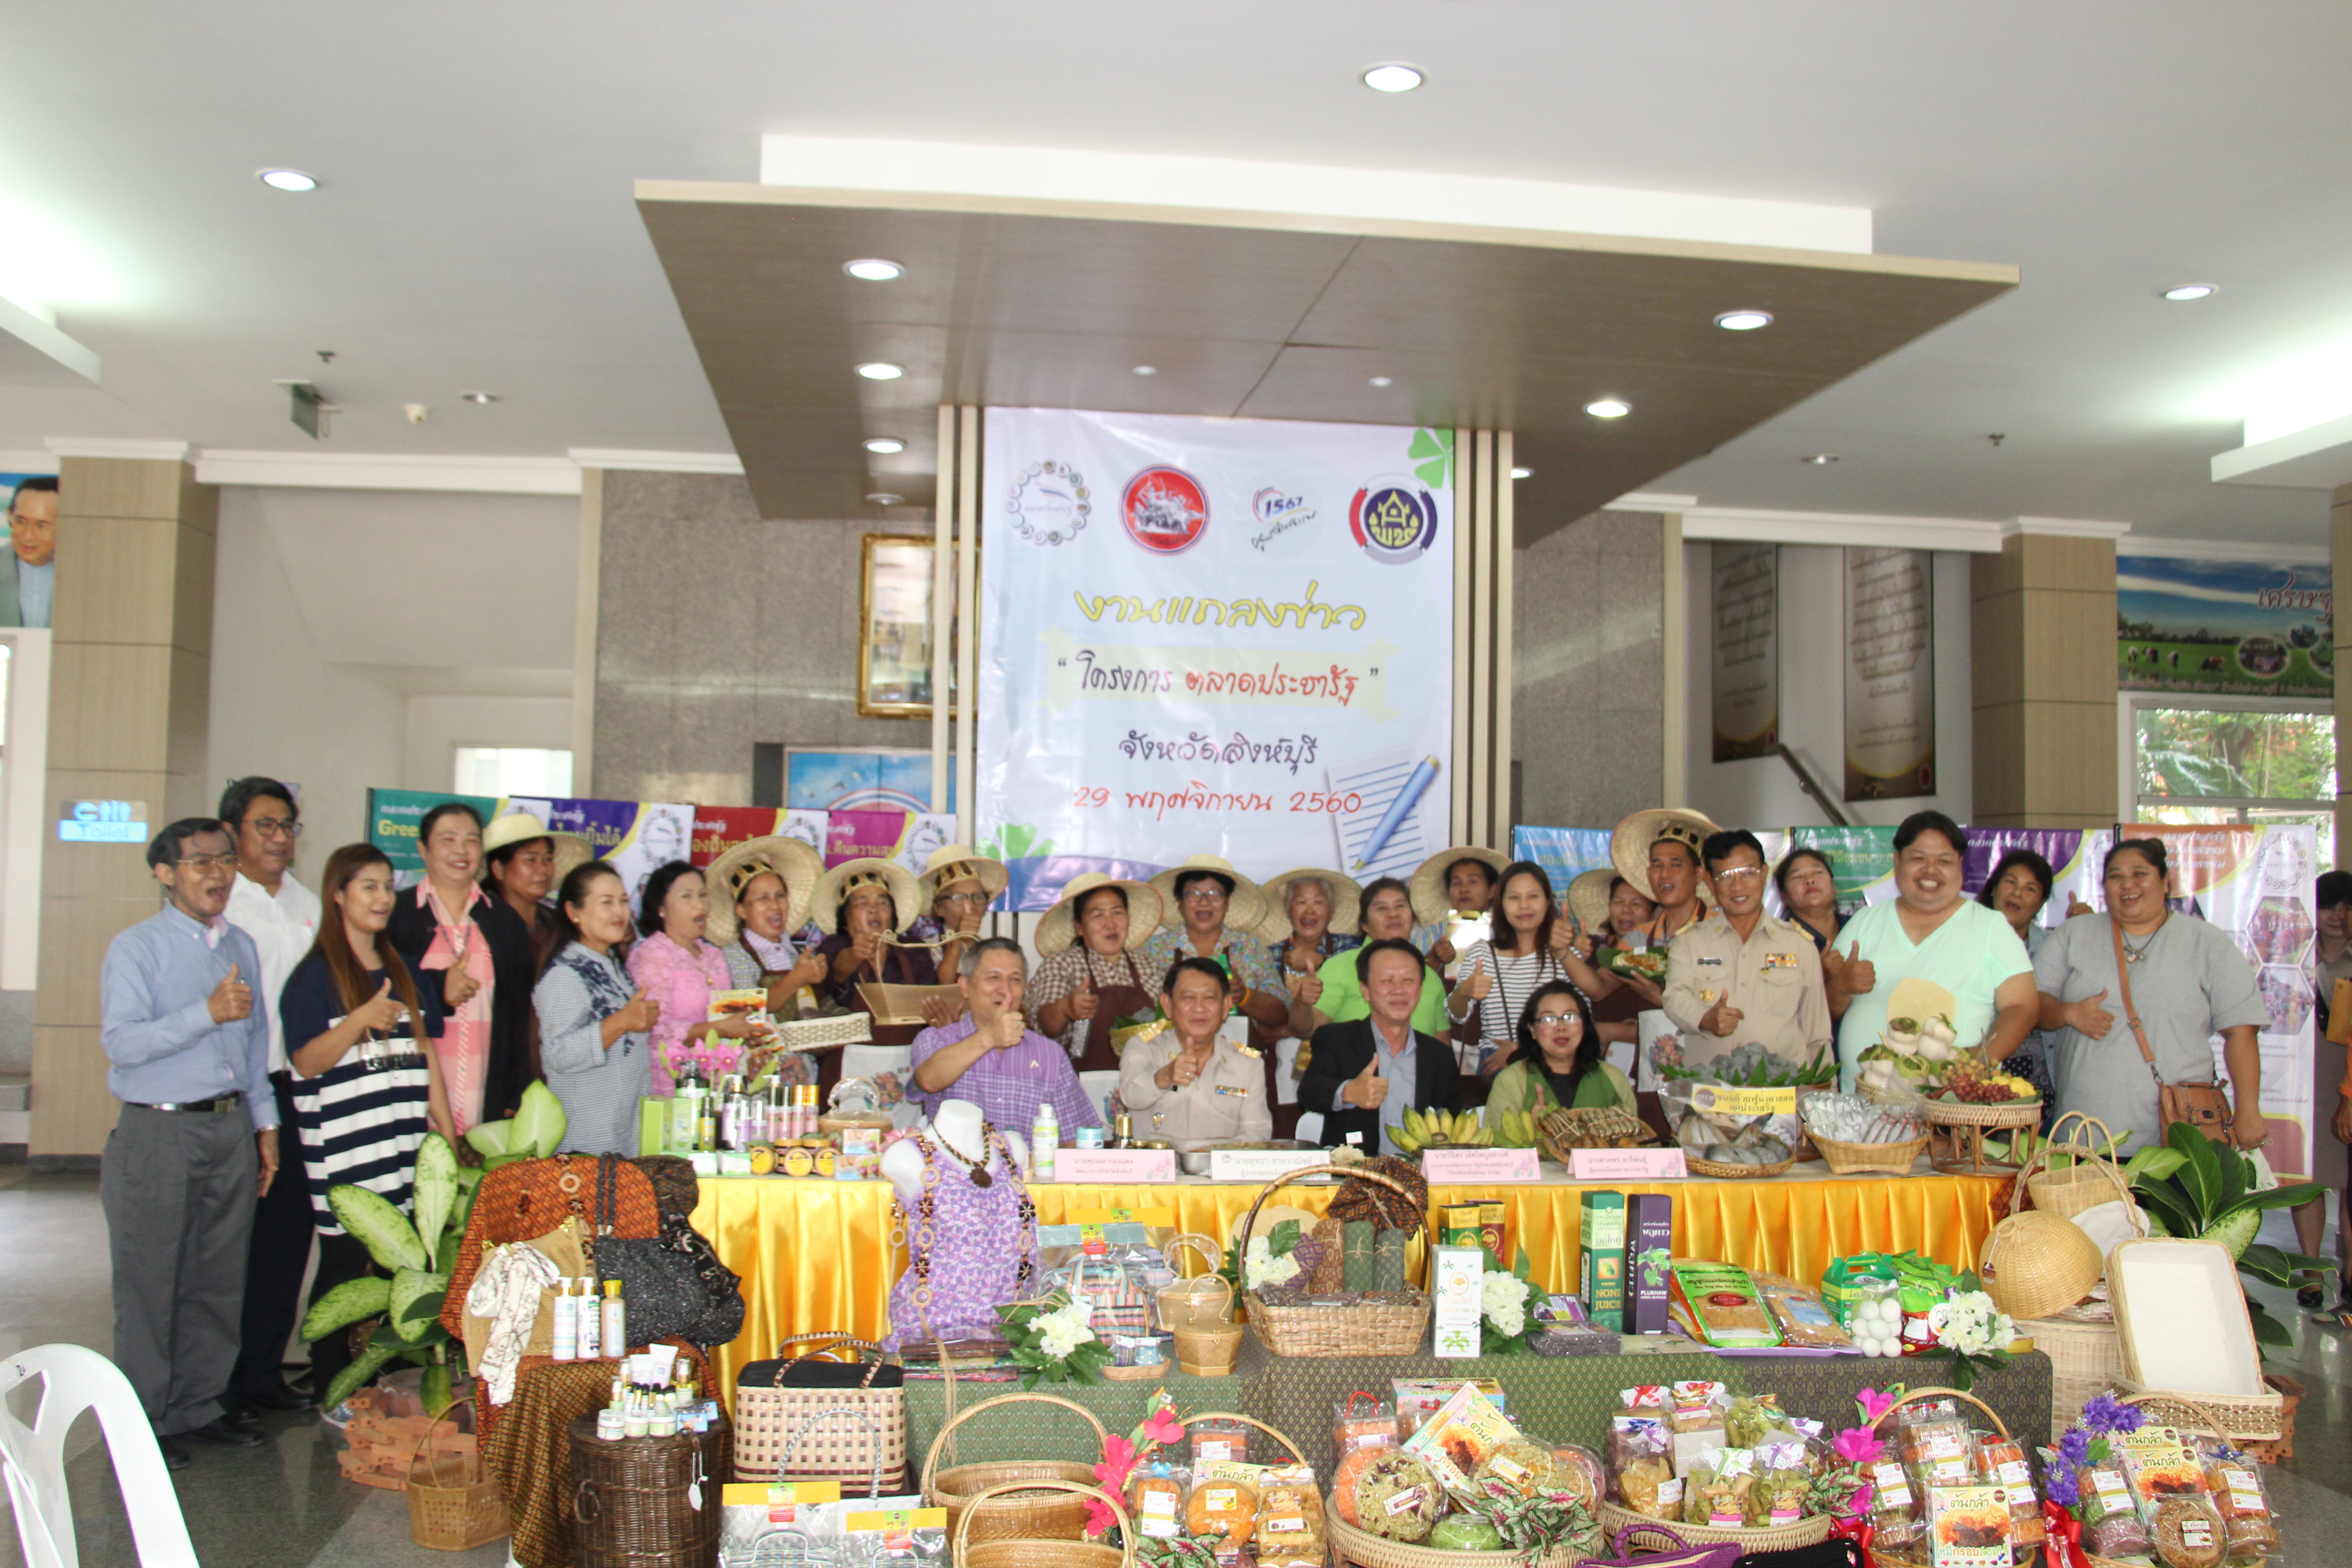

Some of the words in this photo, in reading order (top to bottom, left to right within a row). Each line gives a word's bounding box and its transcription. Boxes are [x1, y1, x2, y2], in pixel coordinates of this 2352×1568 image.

[1265, 496, 1303, 518] 1567
[1073, 580, 1366, 631] งานแถลงข่าว
[1076, 650, 1171, 692] โครงการ
[1119, 730, 1318, 775] จังหวัดสิงห์บุรี
[1073, 787, 1109, 808] 29
[1125, 780, 1273, 821] พฤศจิกายน
[1289, 791, 1362, 813] 2560
[78, 824, 130, 839] Toilet
[377, 819, 420, 838] Gree
[1595, 1289, 1621, 1298] NONI
[1594, 1300, 1621, 1312] JUICE
[2142, 1451, 2181, 1467] ต้นกล้า
[1212, 1465, 1254, 1482] ต้นกล้า
[1950, 1491, 1990, 1509] ต้นกล้า
